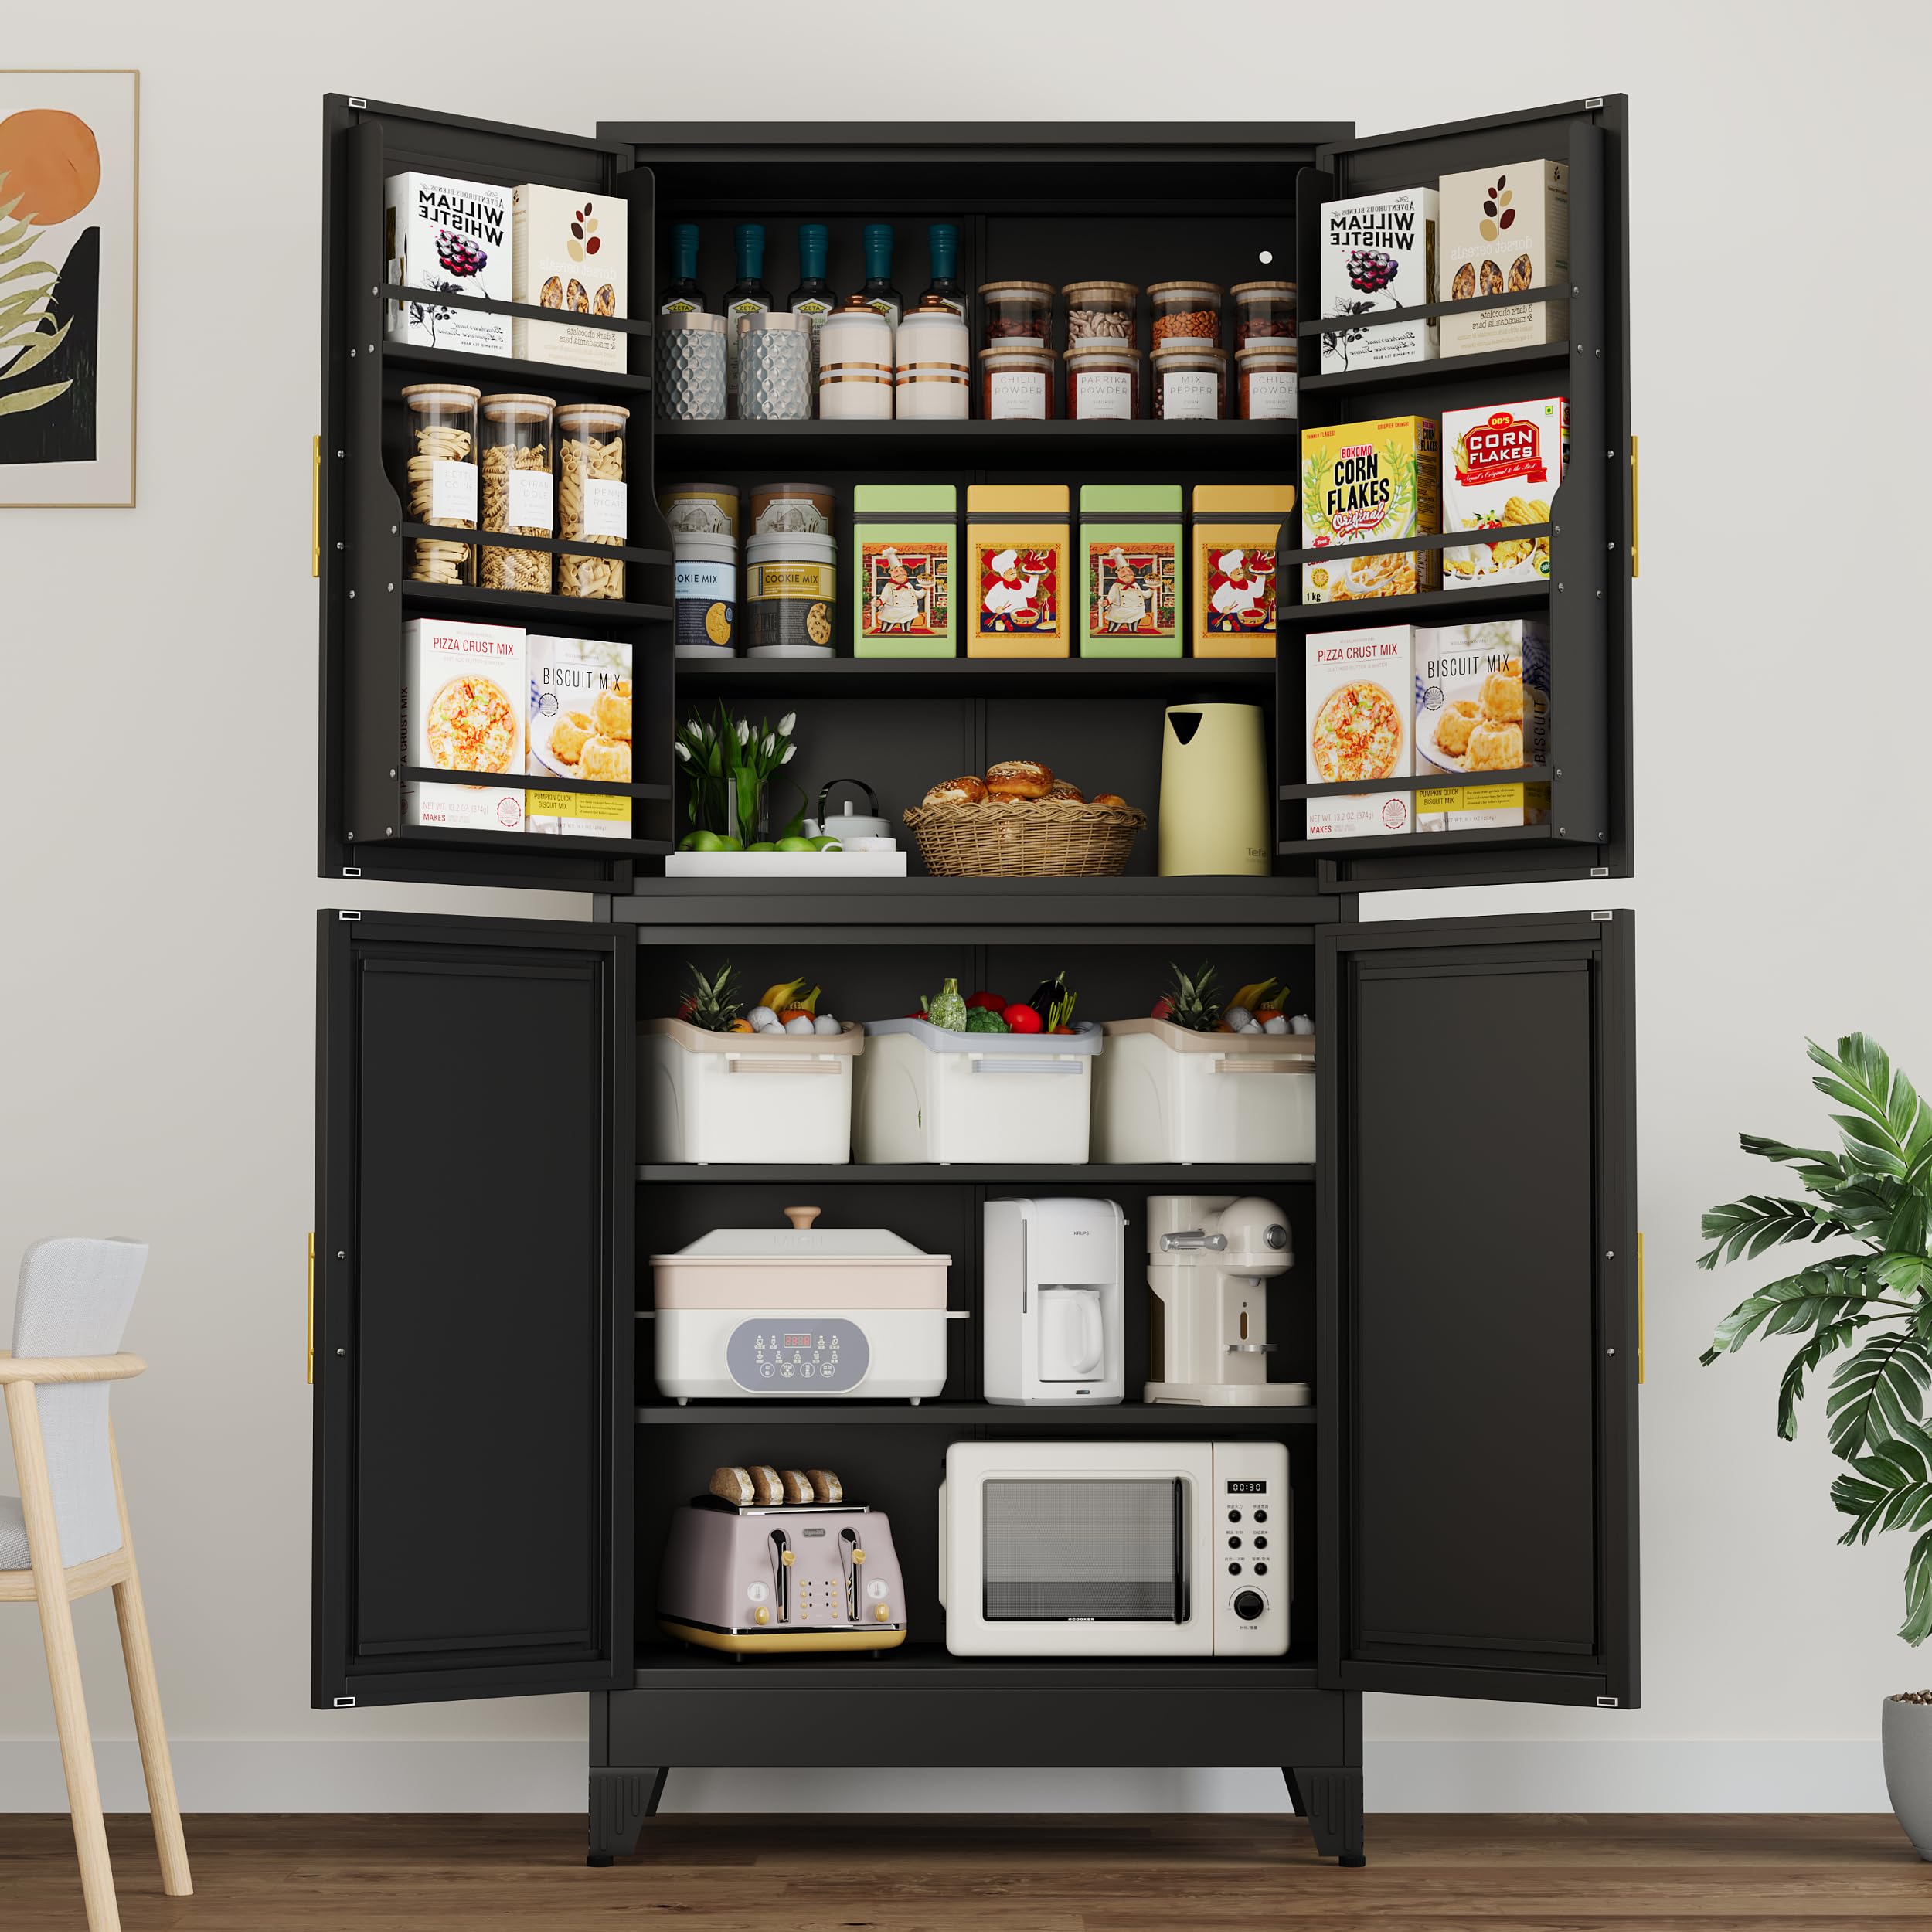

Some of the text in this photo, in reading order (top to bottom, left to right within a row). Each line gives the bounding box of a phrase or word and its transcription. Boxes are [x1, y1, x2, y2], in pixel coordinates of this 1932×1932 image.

[1170, 386, 1213, 395] PEPPER
[1491, 417, 1510, 426] DD'S
[1423, 429, 1435, 440] CORN
[1469, 430, 1532, 451] CORN
[1341, 445, 1372, 459] BOKOMO
[1420, 440, 1438, 452] FLAKES
[1469, 446, 1532, 464] FLAKES
[1335, 454, 1378, 487] CORN
[1327, 478, 1390, 515] FLAKES
[1332, 501, 1386, 531] Original
[702, 575, 718, 583] MIX
[765, 574, 818, 583] COOKIE MIX
[1307, 592, 1321, 602] 1 kg
[434, 637, 514, 656] PIZZA CRUST MIX
[1318, 643, 1398, 662] PIZZA CRUST MIX
[1427, 653, 1509, 679] BISCUIT MIX
[543, 668, 621, 691] BISCUIT MIX
[1533, 662, 1546, 764] BISCUIT MIX
[400, 713, 408, 752] CRUST
[534, 792, 556, 801] PUMPKIN
[1419, 789, 1442, 798] PUMPKIN
[423, 801, 435, 811] NET
[1423, 798, 1444, 806] BISQUIT
[423, 813, 446, 822] MAKES
[1309, 815, 1320, 823] NET
[1346, 812, 1355, 821] OZ
[1356, 811, 1374, 821] (374g)
[1310, 825, 1332, 834] MAKES
[1233, 1483, 1261, 1492] 00:30
